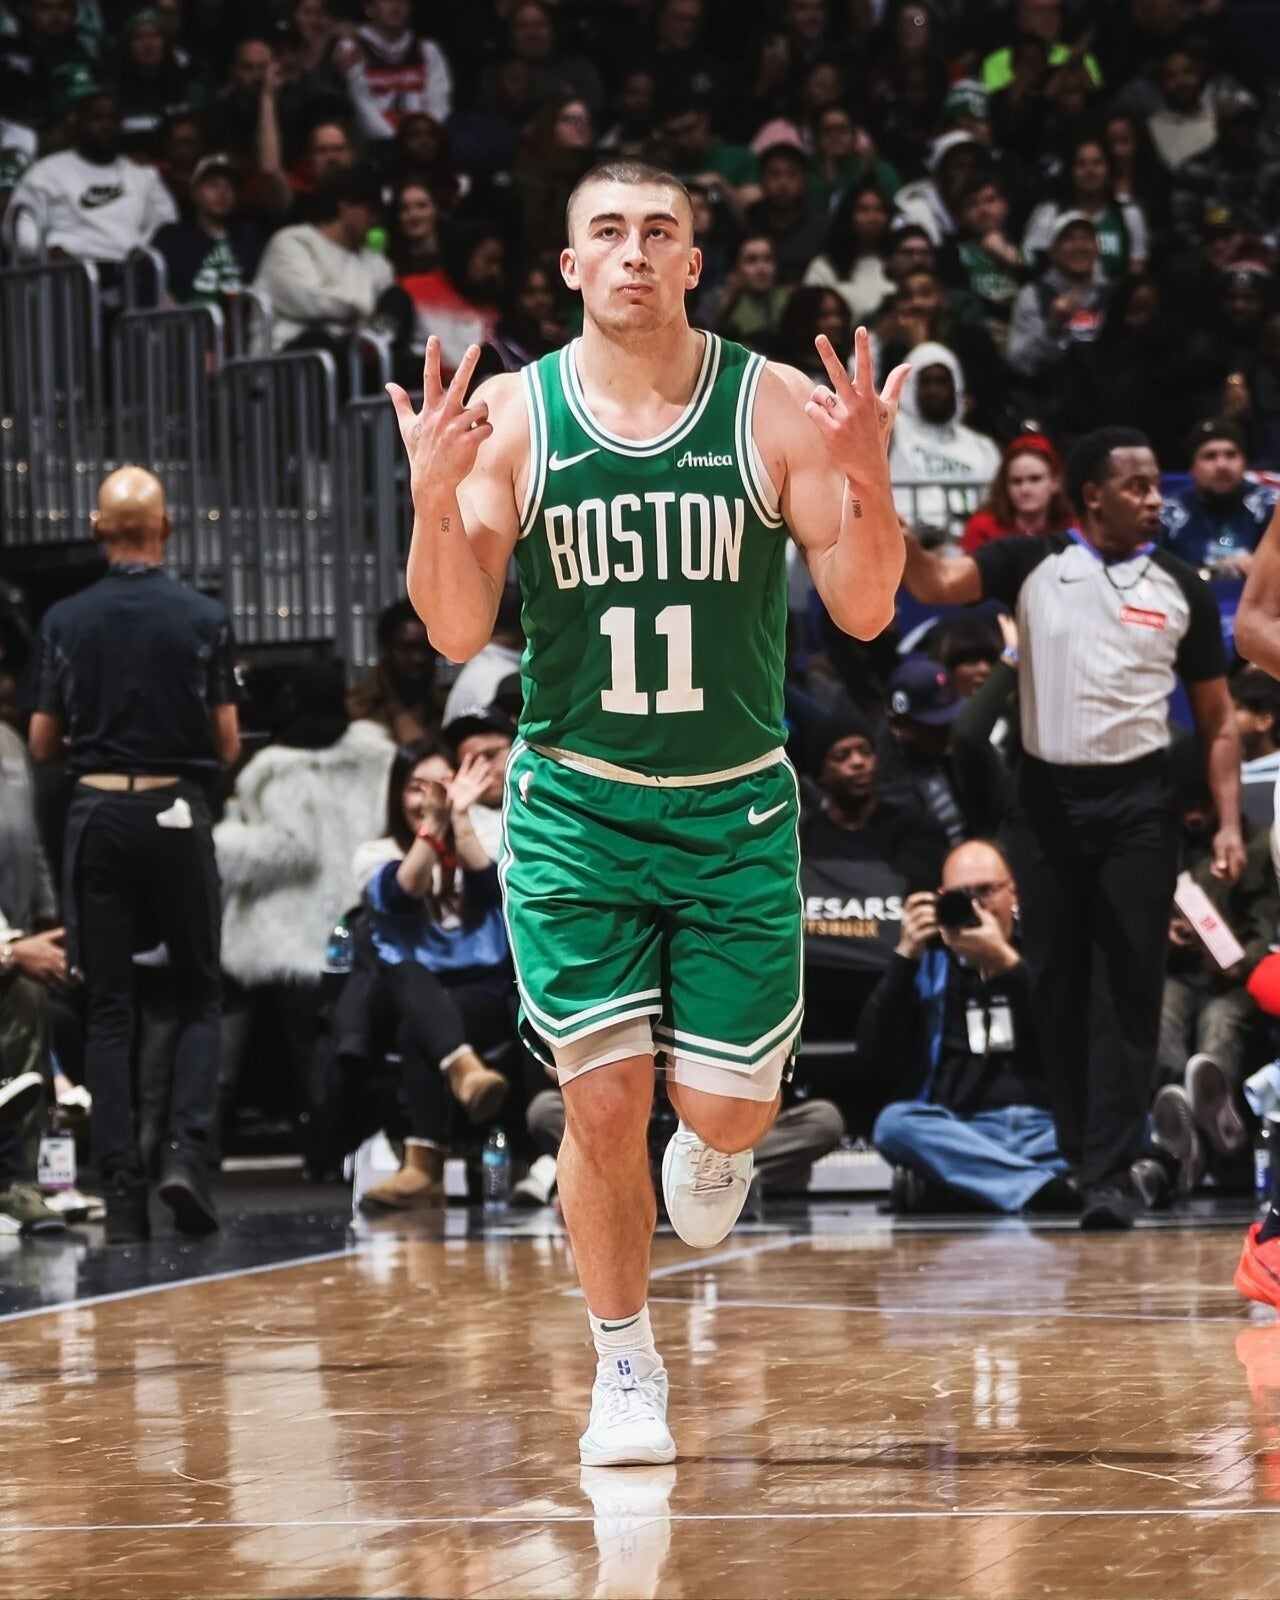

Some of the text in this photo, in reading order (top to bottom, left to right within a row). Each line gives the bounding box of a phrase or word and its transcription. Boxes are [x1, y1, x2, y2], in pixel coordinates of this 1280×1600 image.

[676, 450, 733, 468] Amica
[441, 516, 451, 533] 503
[544, 491, 745, 590] BOSTON
[599, 604, 704, 715] 11
[803, 895, 903, 920] ESARS
